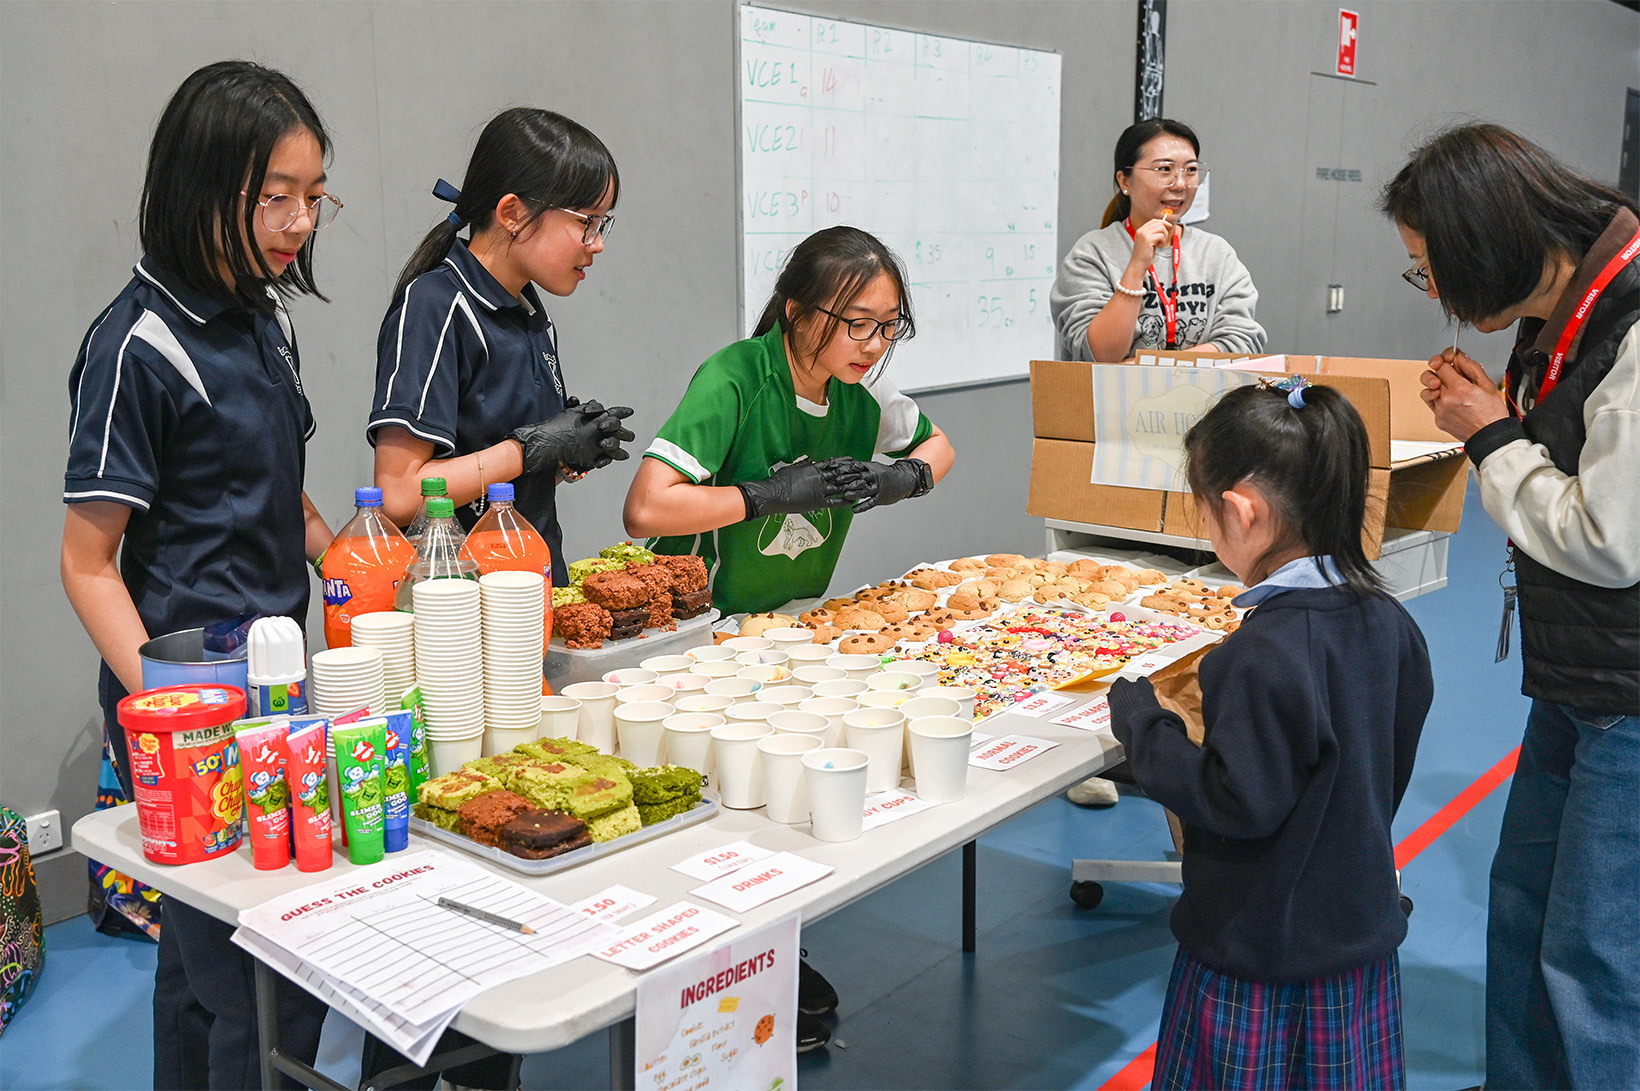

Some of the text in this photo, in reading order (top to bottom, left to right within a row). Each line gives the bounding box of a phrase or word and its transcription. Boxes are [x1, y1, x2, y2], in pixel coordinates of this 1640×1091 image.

[815, 22, 840, 44] R1
[872, 29, 894, 54] R2
[921, 36, 943, 58] R3
[746, 58, 783, 88] VCE
[746, 190, 781, 218] VCE
[1575, 288, 1599, 320] VISITOR
[1548, 352, 1564, 381] VISITOR
[1135, 409, 1198, 435] AIR HO
[323, 578, 352, 598] ANTA
[183, 726, 220, 743] MADE
[976, 741, 1017, 760] NORMAL
[998, 744, 1039, 764] COOKIES
[350, 803, 382, 817] SLIMER
[366, 807, 383, 819] GOO
[881, 796, 916, 810] CUPS
[703, 851, 740, 866] $1.50
[731, 868, 784, 892] DRINKS
[280, 864, 435, 922] GUESS THE COOKIES
[600, 931, 652, 957] LETTER
[651, 907, 700, 934] SHAPED
[647, 926, 700, 953] COOKIES
[681, 949, 775, 1010] INGREDIENTS
